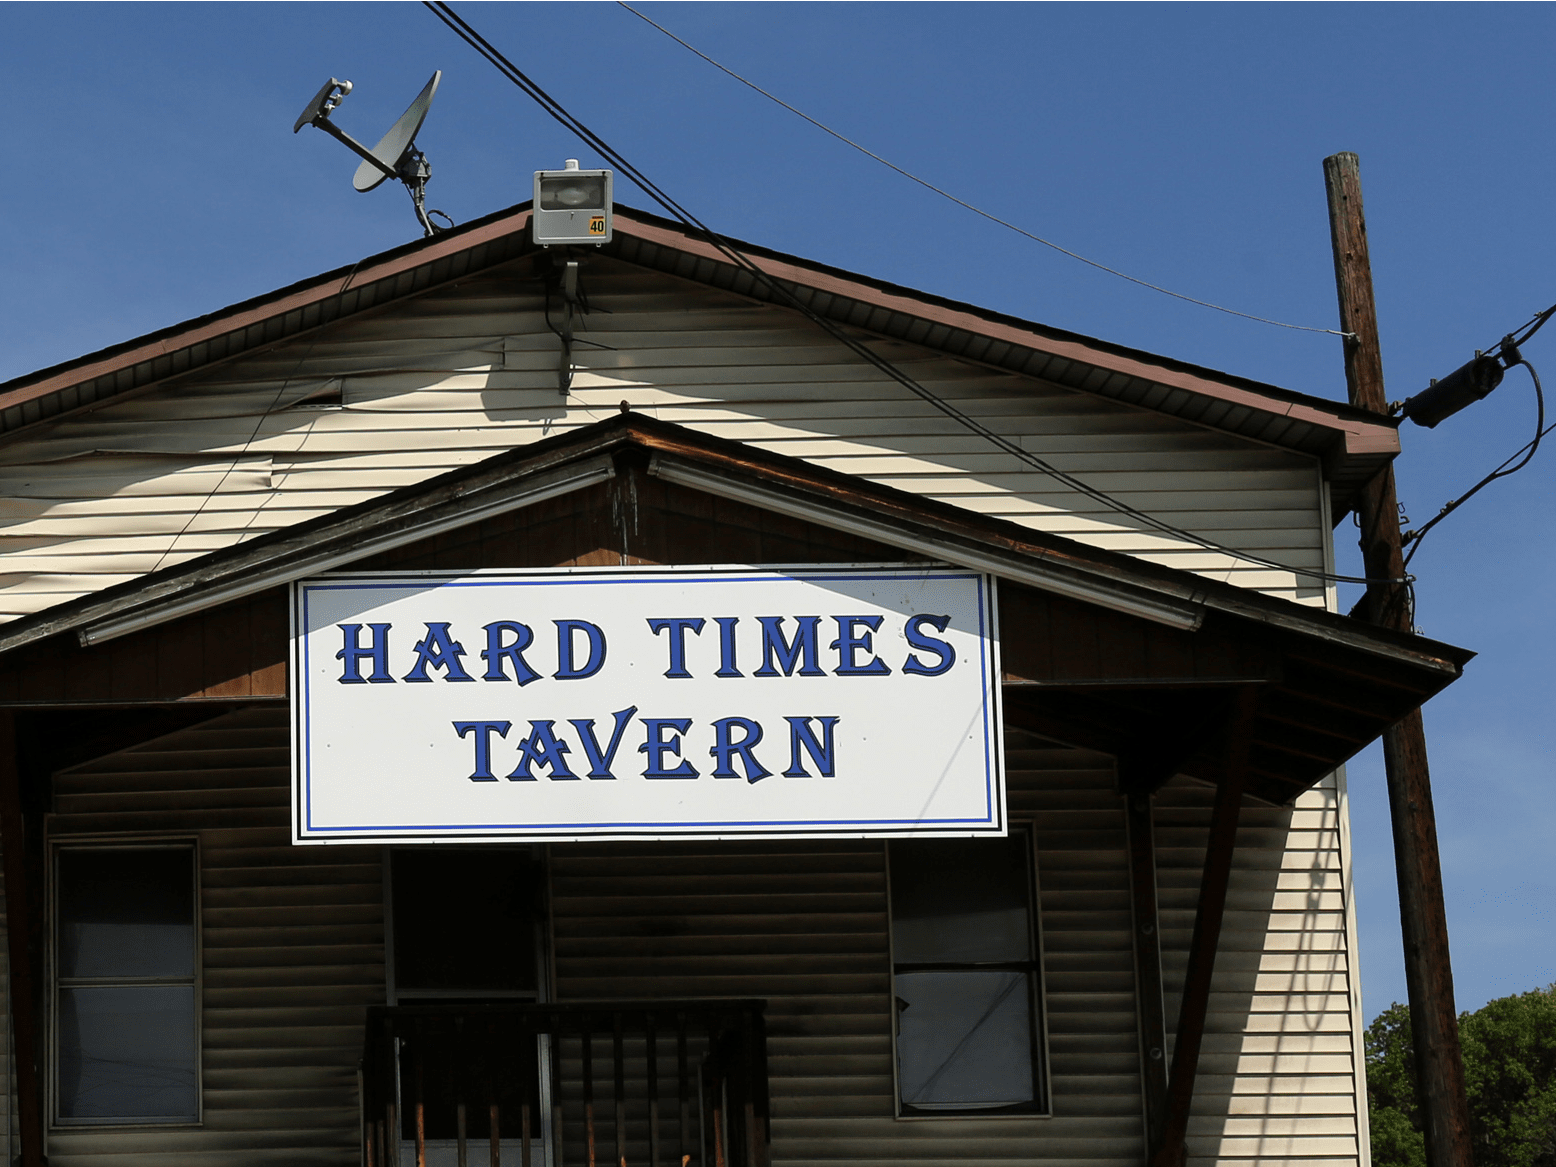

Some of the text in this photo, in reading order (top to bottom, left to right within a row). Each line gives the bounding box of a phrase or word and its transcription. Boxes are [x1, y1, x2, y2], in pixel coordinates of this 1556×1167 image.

[590, 220, 604, 232] 40
[336, 613, 957, 687] HARD TIMES
[451, 705, 841, 784] TAVERN
